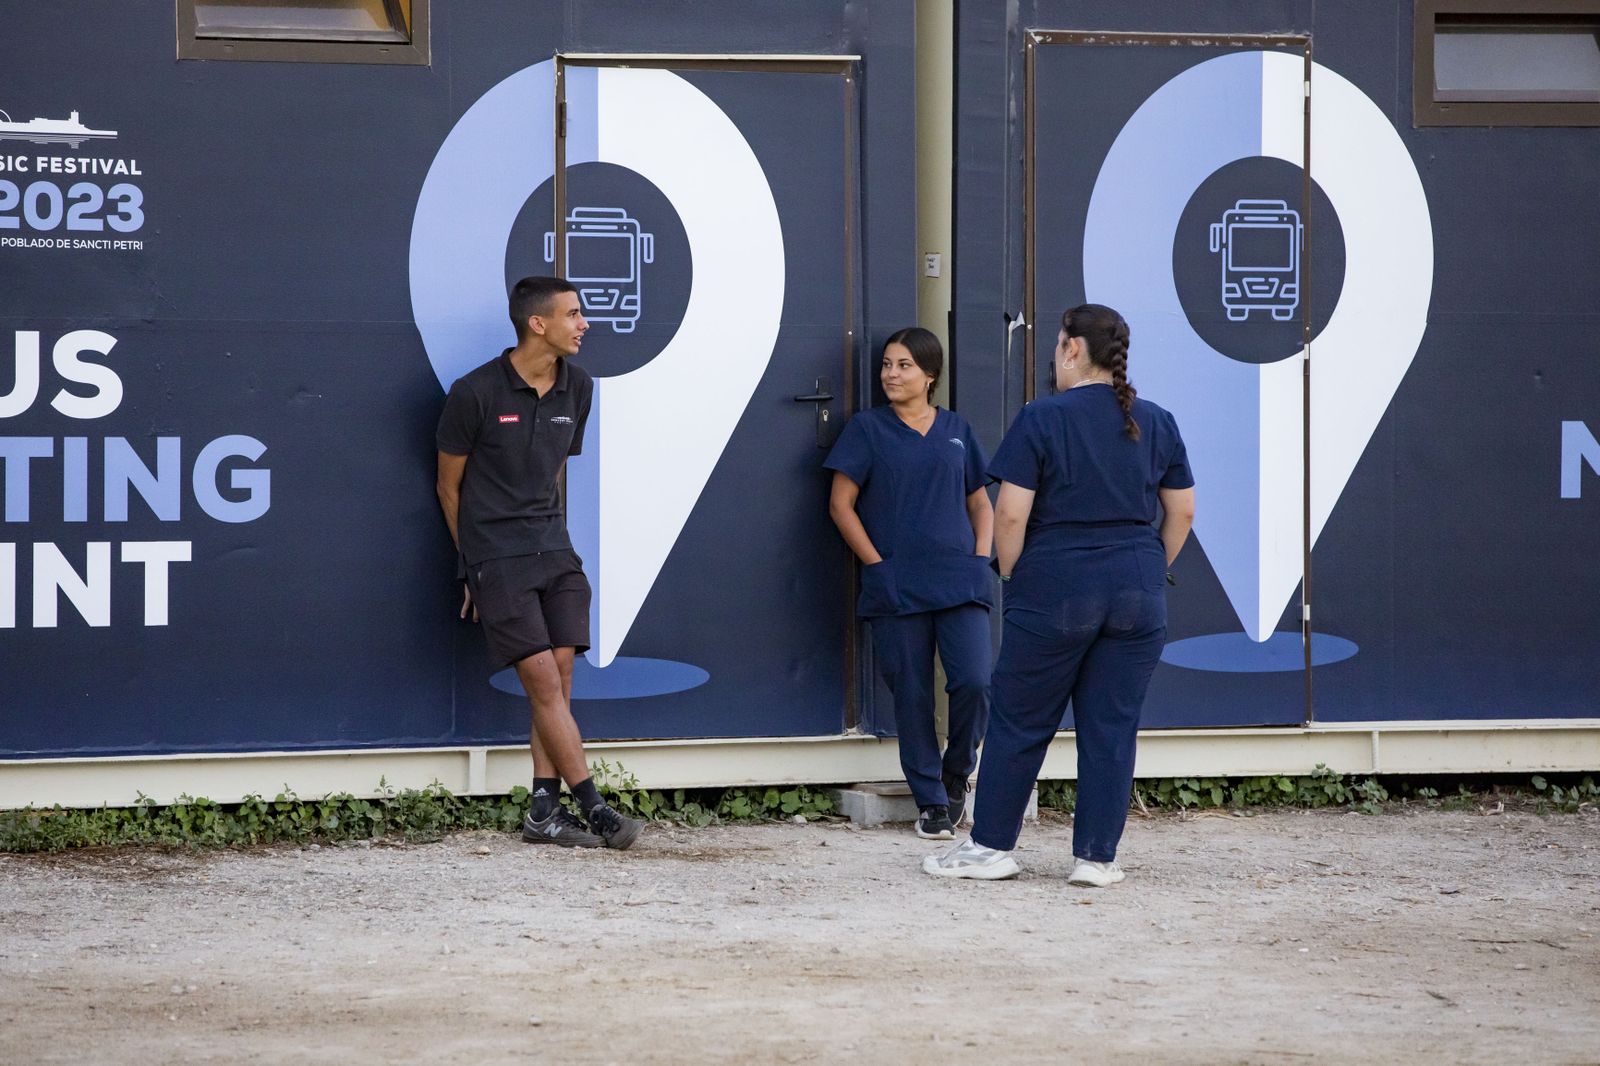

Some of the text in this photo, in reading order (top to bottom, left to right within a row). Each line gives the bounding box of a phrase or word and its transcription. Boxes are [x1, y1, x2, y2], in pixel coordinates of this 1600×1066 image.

[36, 156, 142, 175] FESTIVAL
[0, 179, 145, 233] 2023
[1, 237, 144, 251] POBLADO DE SANCTI PETRI
[0, 329, 124, 420] US
[0, 434, 271, 524] TING
[0, 540, 193, 629] INT
